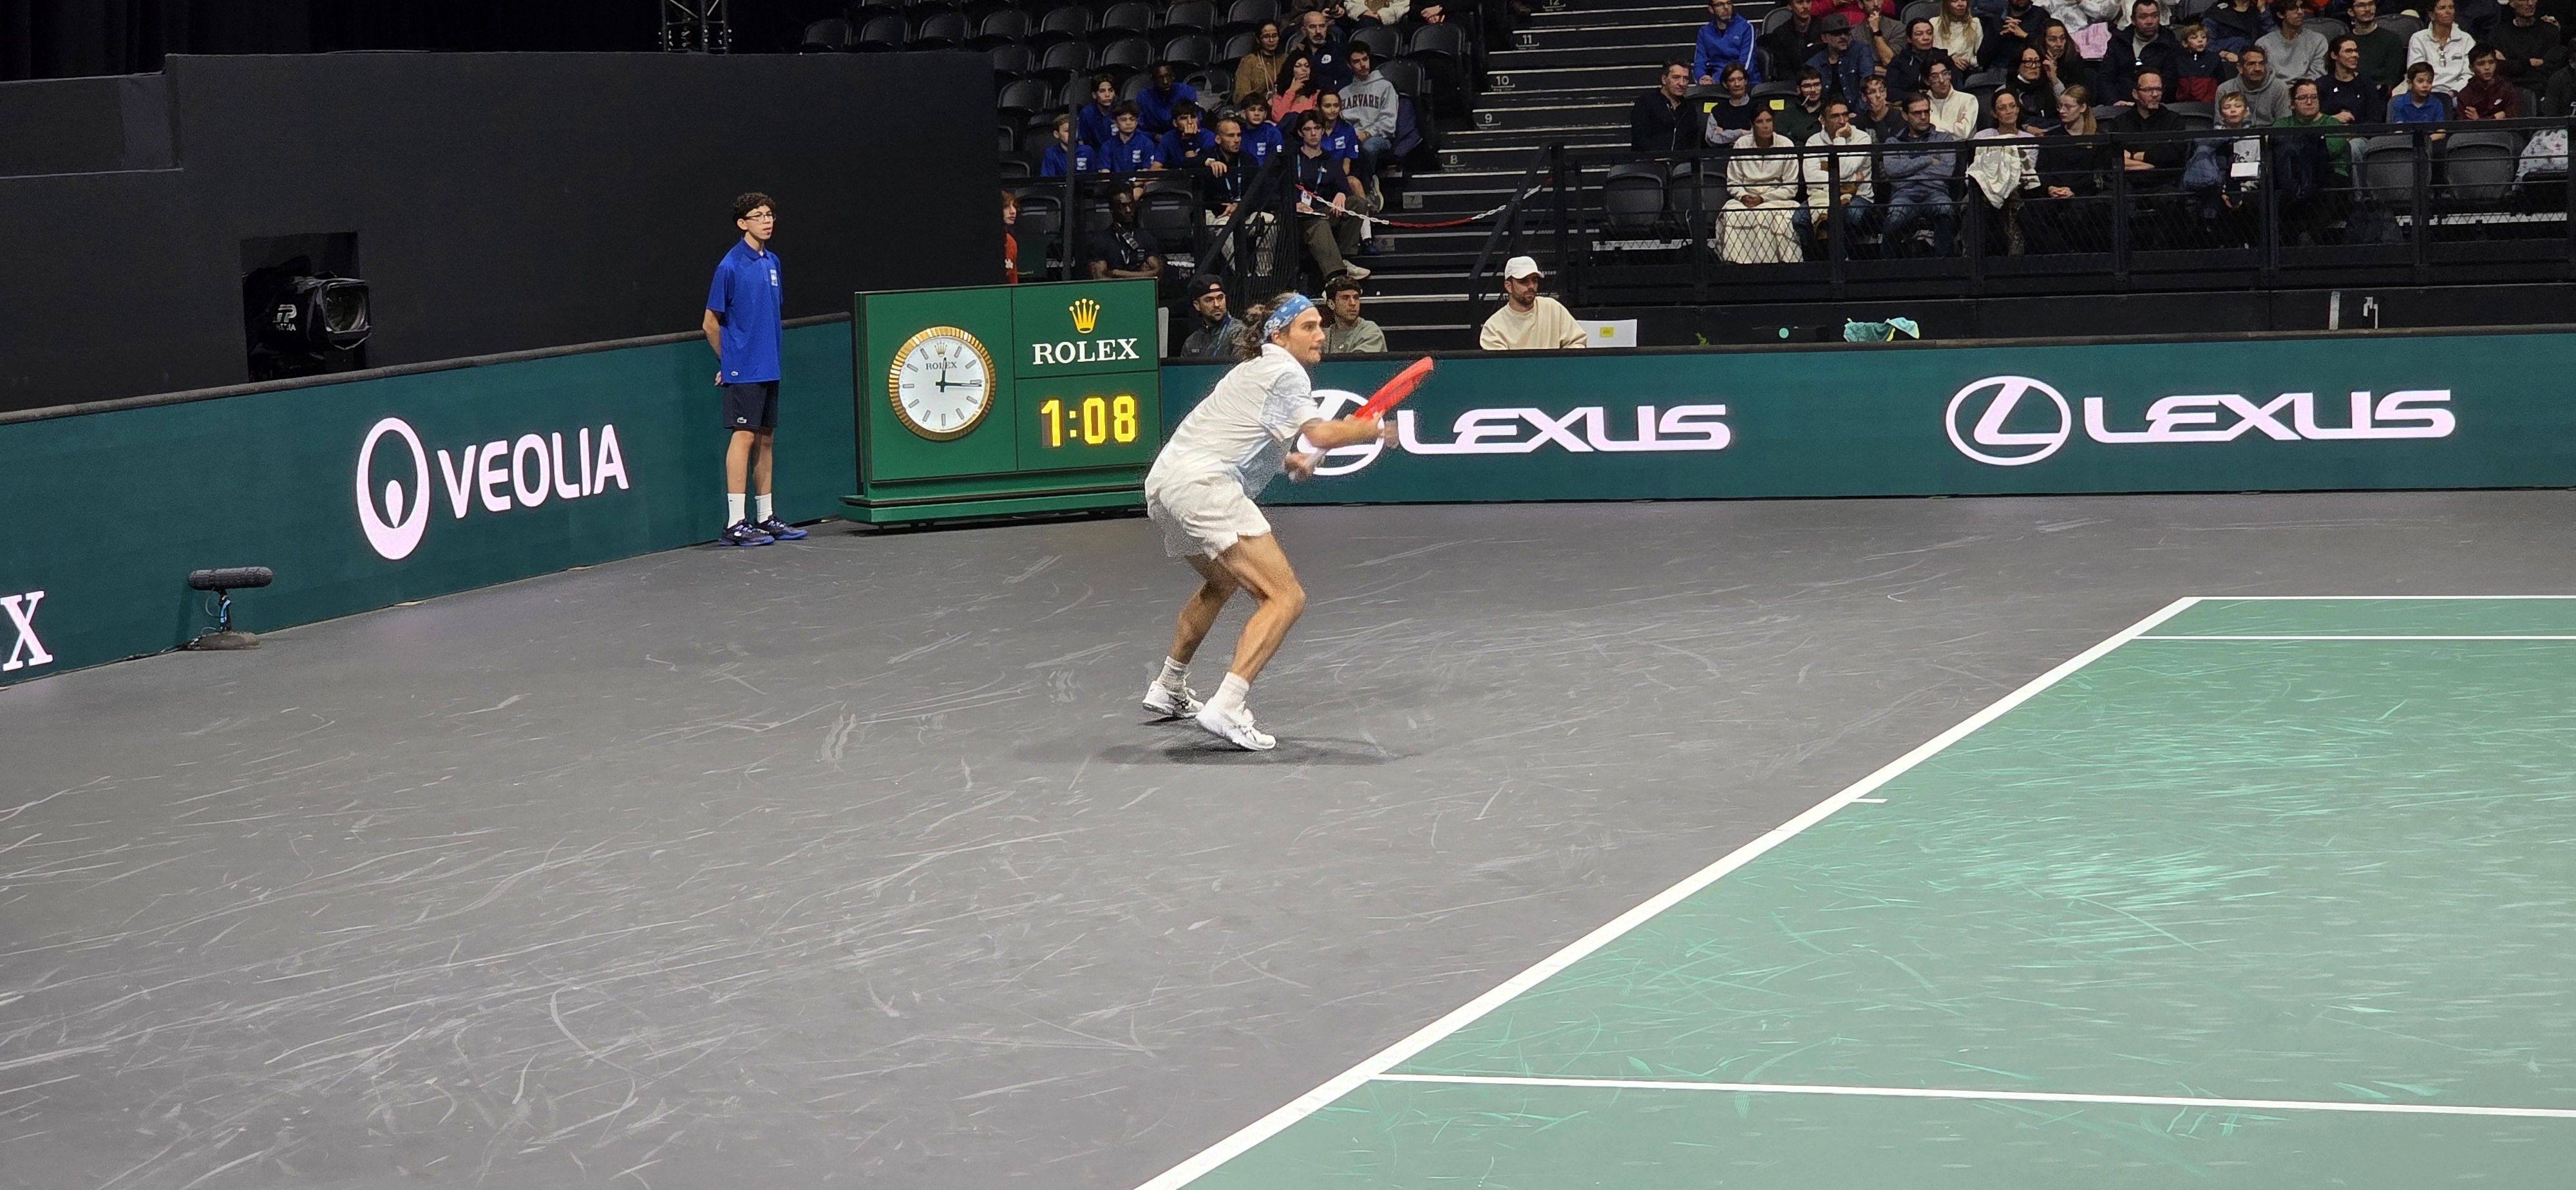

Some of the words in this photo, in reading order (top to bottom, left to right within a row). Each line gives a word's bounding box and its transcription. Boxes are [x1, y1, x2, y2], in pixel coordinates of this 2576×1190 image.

[1522, 35, 1532, 44] 11
[1495, 75, 1510, 85] 10
[1484, 113, 1493, 123] 9
[1450, 155, 1458, 164] 8
[1032, 338, 1140, 365] ROLEX
[1041, 395, 1136, 447] 1:08
[1396, 404, 1731, 455] LEXUS
[2083, 389, 2456, 444] LEXUS
[437, 424, 629, 519] VEOLIA
[0, 590, 53, 672] X
